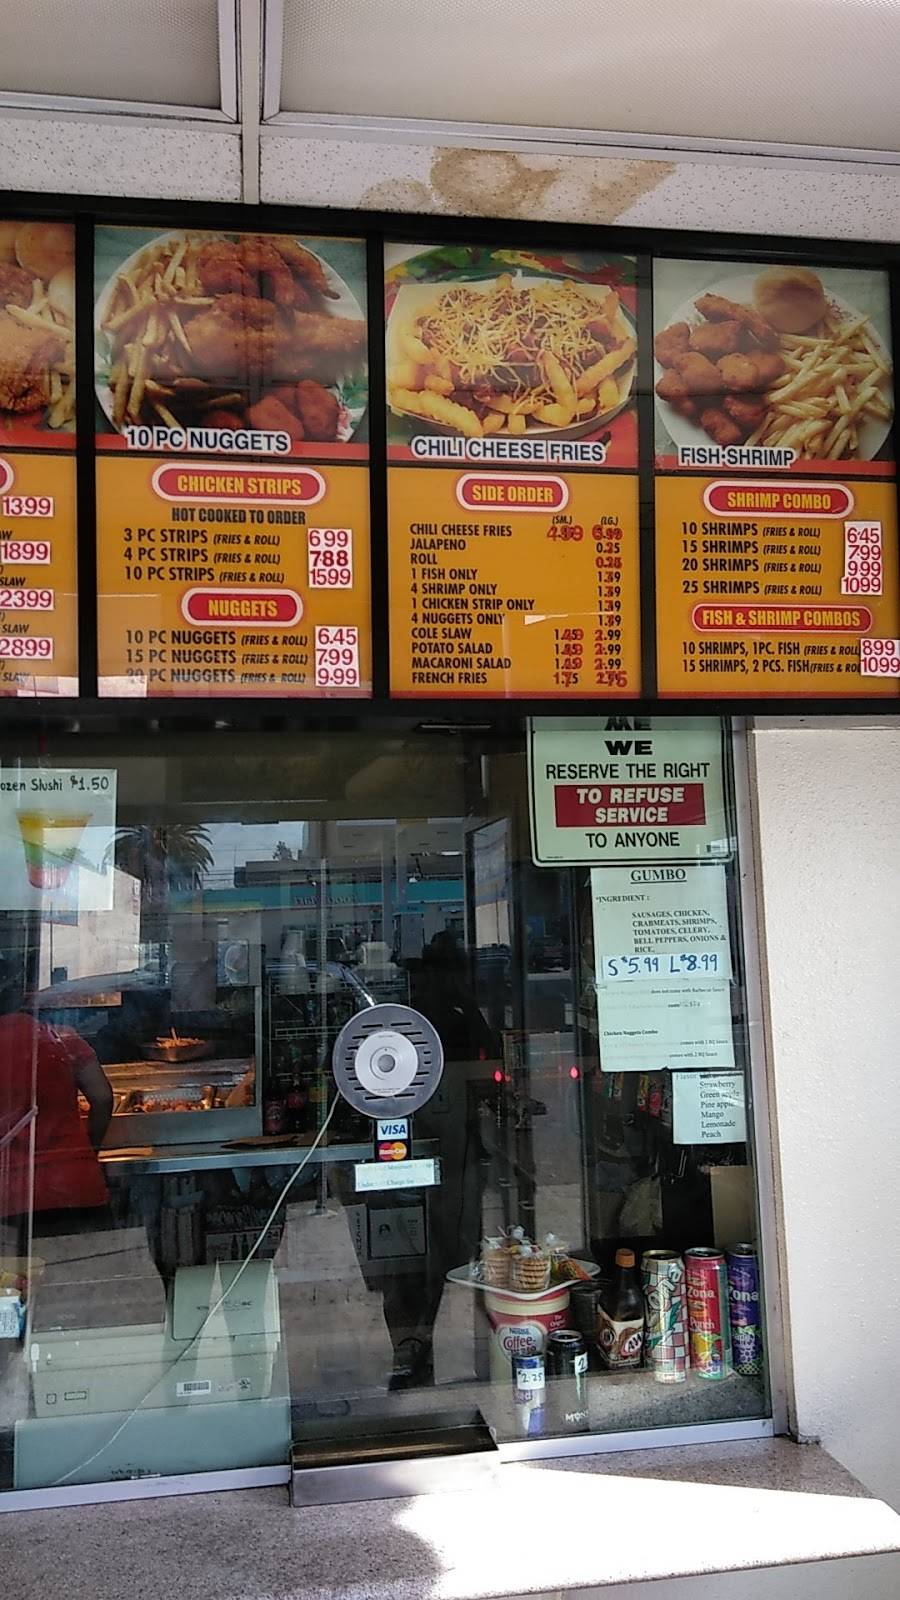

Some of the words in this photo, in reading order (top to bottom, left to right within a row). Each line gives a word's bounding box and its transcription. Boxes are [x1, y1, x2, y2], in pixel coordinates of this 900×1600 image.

[128, 428, 149, 446] 10
[157, 431, 183, 447] PC
[190, 432, 288, 451] NUGGETS
[415, 439, 463, 456] CHILI
[469, 441, 544, 459] CHEESE
[550, 443, 603, 461] FRIES
[177, 475, 243, 494] CHICKEN
[248, 479, 301, 495] STRIPS
[472, 486, 504, 501] SIDE
[507, 487, 553, 502] ORDER
[728, 492, 780, 508] SHRIMP
[782, 494, 831, 510] COMBO
[172, 508, 195, 522] HOT
[199, 509, 246, 523] COOKED
[249, 510, 265, 524] TO
[267, 511, 305, 525] ORDER
[410, 524, 437, 535] CHILI
[442, 525, 480, 536] CHEESE
[484, 526, 512, 536] FRIES
[682, 523, 697, 535] 10
[702, 523, 758, 535] SHRIMPS
[124, 528, 132, 542] 3
[138, 529, 155, 542] PC
[160, 530, 208, 543] STRIPS
[213, 534, 241, 545] (FRIES
[254, 534, 280, 546] ROLL)
[410, 539, 466, 550] JALAPENO
[682, 541, 697, 553] 15
[702, 541, 758, 553] SHRIMPS
[124, 548, 132, 561] 4
[139, 548, 156, 561] PC
[161, 548, 208, 562] STRIPS
[410, 553, 437, 564] ROLL
[682, 559, 697, 571] 20
[703, 559, 759, 572] SHRIMPS
[126, 567, 142, 580] 10
[148, 567, 166, 580] PC
[169, 567, 214, 581] STRIPS
[411, 569, 416, 579] 1
[422, 569, 445, 579] FISH
[450, 569, 478, 580] ONLY
[411, 584, 417, 594] 4
[422, 584, 465, 594] SHRIMP
[469, 584, 497, 595] ONLY
[683, 581, 698, 593] 25
[703, 581, 759, 594] SHRIMPS
[764, 586, 789, 595] (FRIES
[799, 586, 822, 595] ROLL)
[208, 600, 278, 617] NUGGETS
[411, 598, 416, 608] 1
[422, 599, 468, 609] CHICKEN
[473, 599, 502, 609] STRIP
[507, 599, 534, 610] ONLY
[411, 613, 418, 623] 4
[422, 613, 474, 624] NUGGETS
[477, 614, 505, 625] ONLY
[703, 611, 732, 625] FISH
[736, 612, 746, 625] &
[749, 611, 800, 626] SHRIMP
[803, 611, 860, 626] COMBOS
[2, 624, 29, 633] SLAW
[411, 628, 437, 639] COLE
[442, 628, 472, 639] SLAW
[126, 631, 143, 644] 10
[149, 631, 166, 644] PC
[171, 631, 235, 645] NUGGETS
[241, 635, 269, 646] (FRIES
[282, 635, 308, 647] ROLL)
[319, 629, 356, 645] 6.45
[411, 643, 454, 654] POTATO
[458, 643, 492, 654] SALAD
[683, 643, 695, 654] 10
[699, 643, 749, 656] SHRIMPS,
[778, 643, 799, 655] FISH
[804, 646, 829, 656] (FRIES
[126, 650, 143, 662] 15
[149, 650, 166, 663] PC
[171, 650, 236, 664] NUGGETS
[412, 658, 472, 669] MACARONI
[477, 658, 511, 669] SALAD
[683, 660, 695, 672] 15
[699, 660, 749, 674] SHRIMPS,
[753, 661, 759, 672] 2
[763, 661, 784, 673] PCS.
[150, 669, 166, 682] PC
[171, 669, 235, 683] NUGGETS
[412, 672, 454, 683] FRENCH
[458, 673, 487, 684] FRIES
[605, 741, 653, 755] WE
[546, 764, 619, 779] RESERVE
[626, 764, 656, 778] THE
[664, 763, 710, 777] RIGHT
[31, 779, 62, 791] Slushi
[70, 776, 109, 790] $1.50
[577, 789, 602, 804] TO
[610, 787, 684, 804] REFUSE
[595, 807, 668, 823] SERVICE
[586, 833, 607, 848] TO
[615, 832, 680, 847] ANYONE
[631, 869, 686, 882] GUMBO
[608, 959, 618, 976] S
[622, 956, 659, 974] $5.99
[670, 956, 680, 973] L
[680, 954, 718, 971] $8.99
[701, 1111, 724, 1119] Mango
[381, 1125, 406, 1135] VISA
[690, 1319, 714, 1330] Punch
